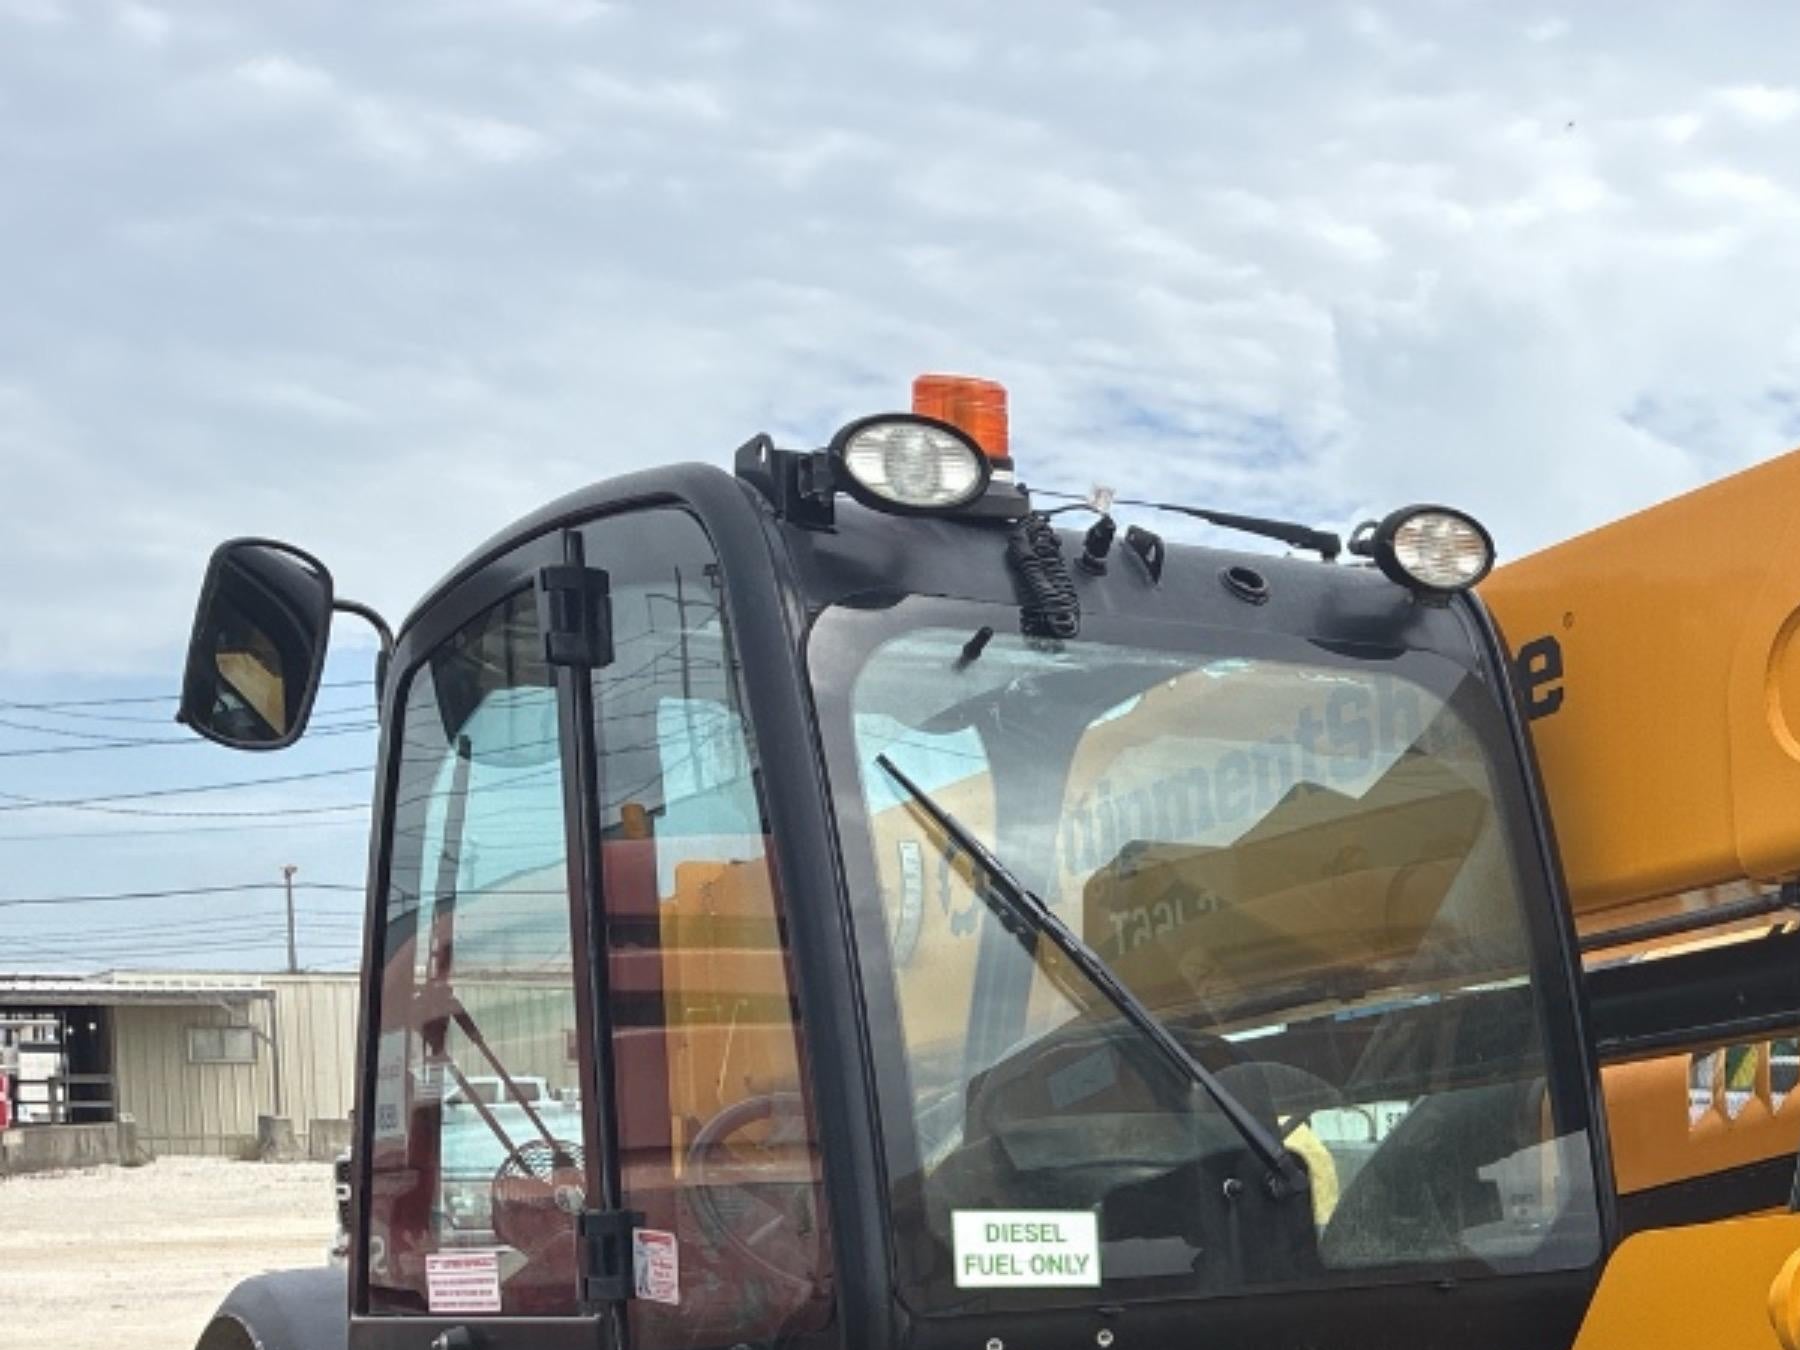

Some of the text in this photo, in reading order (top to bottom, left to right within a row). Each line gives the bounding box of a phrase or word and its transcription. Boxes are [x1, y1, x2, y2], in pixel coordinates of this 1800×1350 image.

[985, 1222, 1067, 1243] DIESEL
[963, 1253, 1090, 1276] FUEL ONLY
